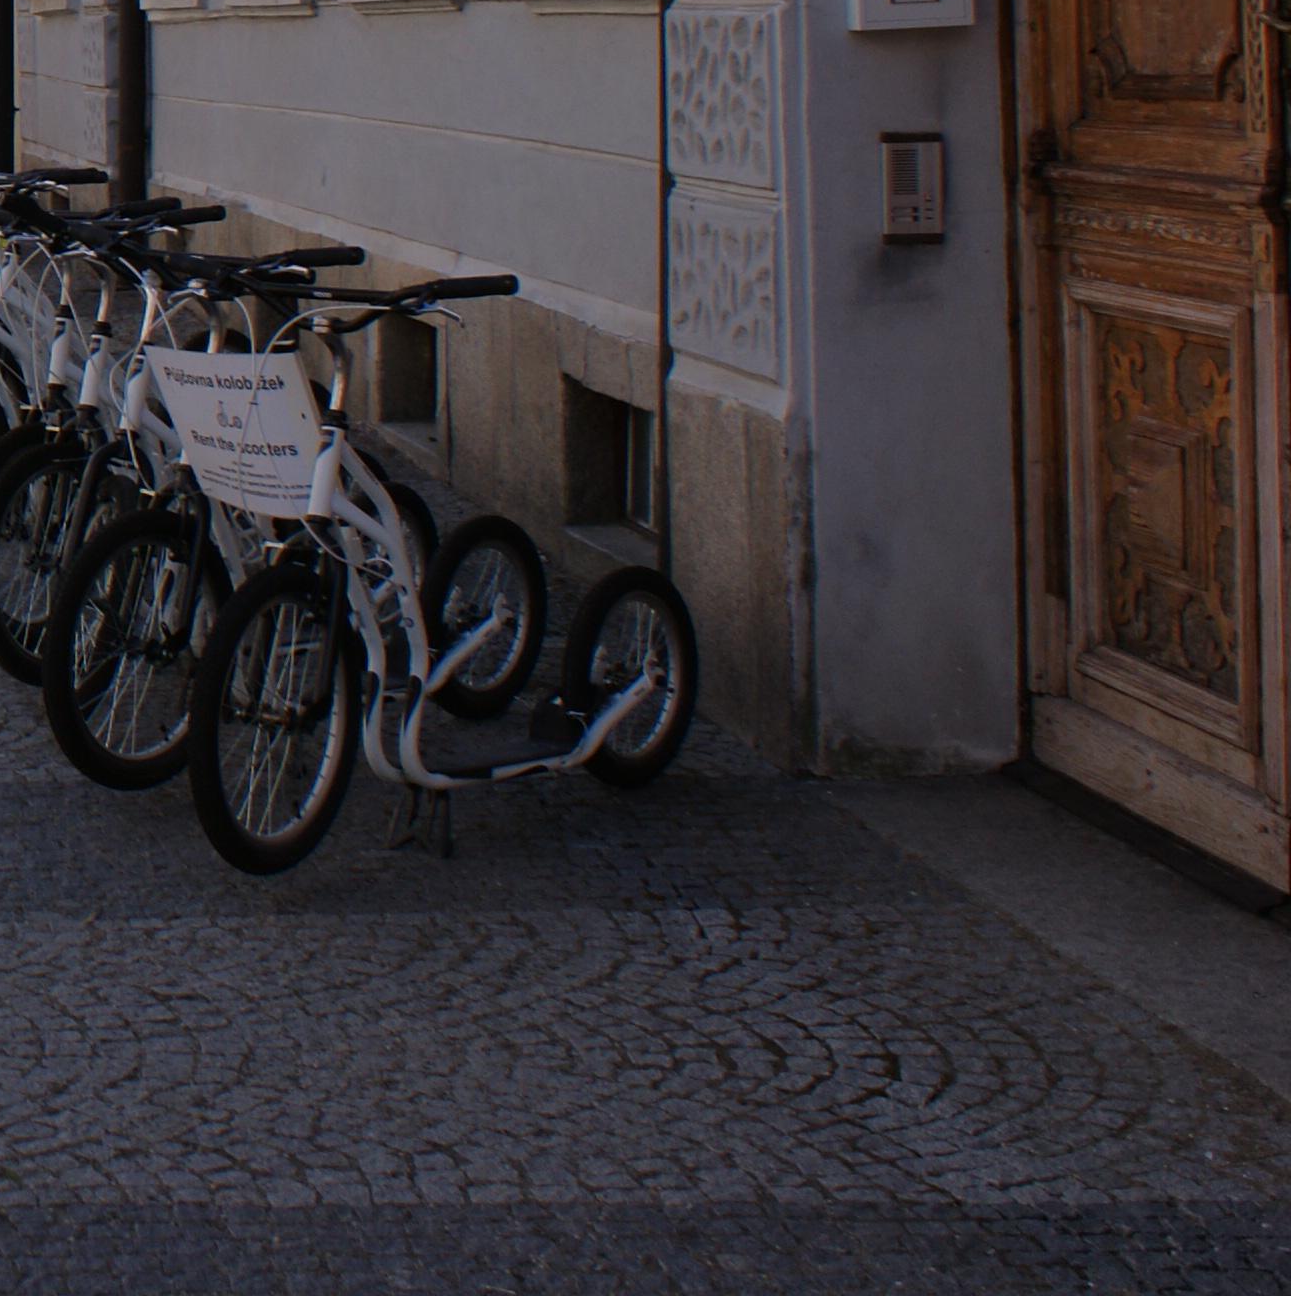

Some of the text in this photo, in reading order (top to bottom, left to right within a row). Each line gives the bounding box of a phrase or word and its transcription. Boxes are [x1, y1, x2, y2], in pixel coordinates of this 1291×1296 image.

[163, 366, 214, 388] Půjčovna
[191, 430, 217, 448] Rent
[217, 436, 236, 452] the
